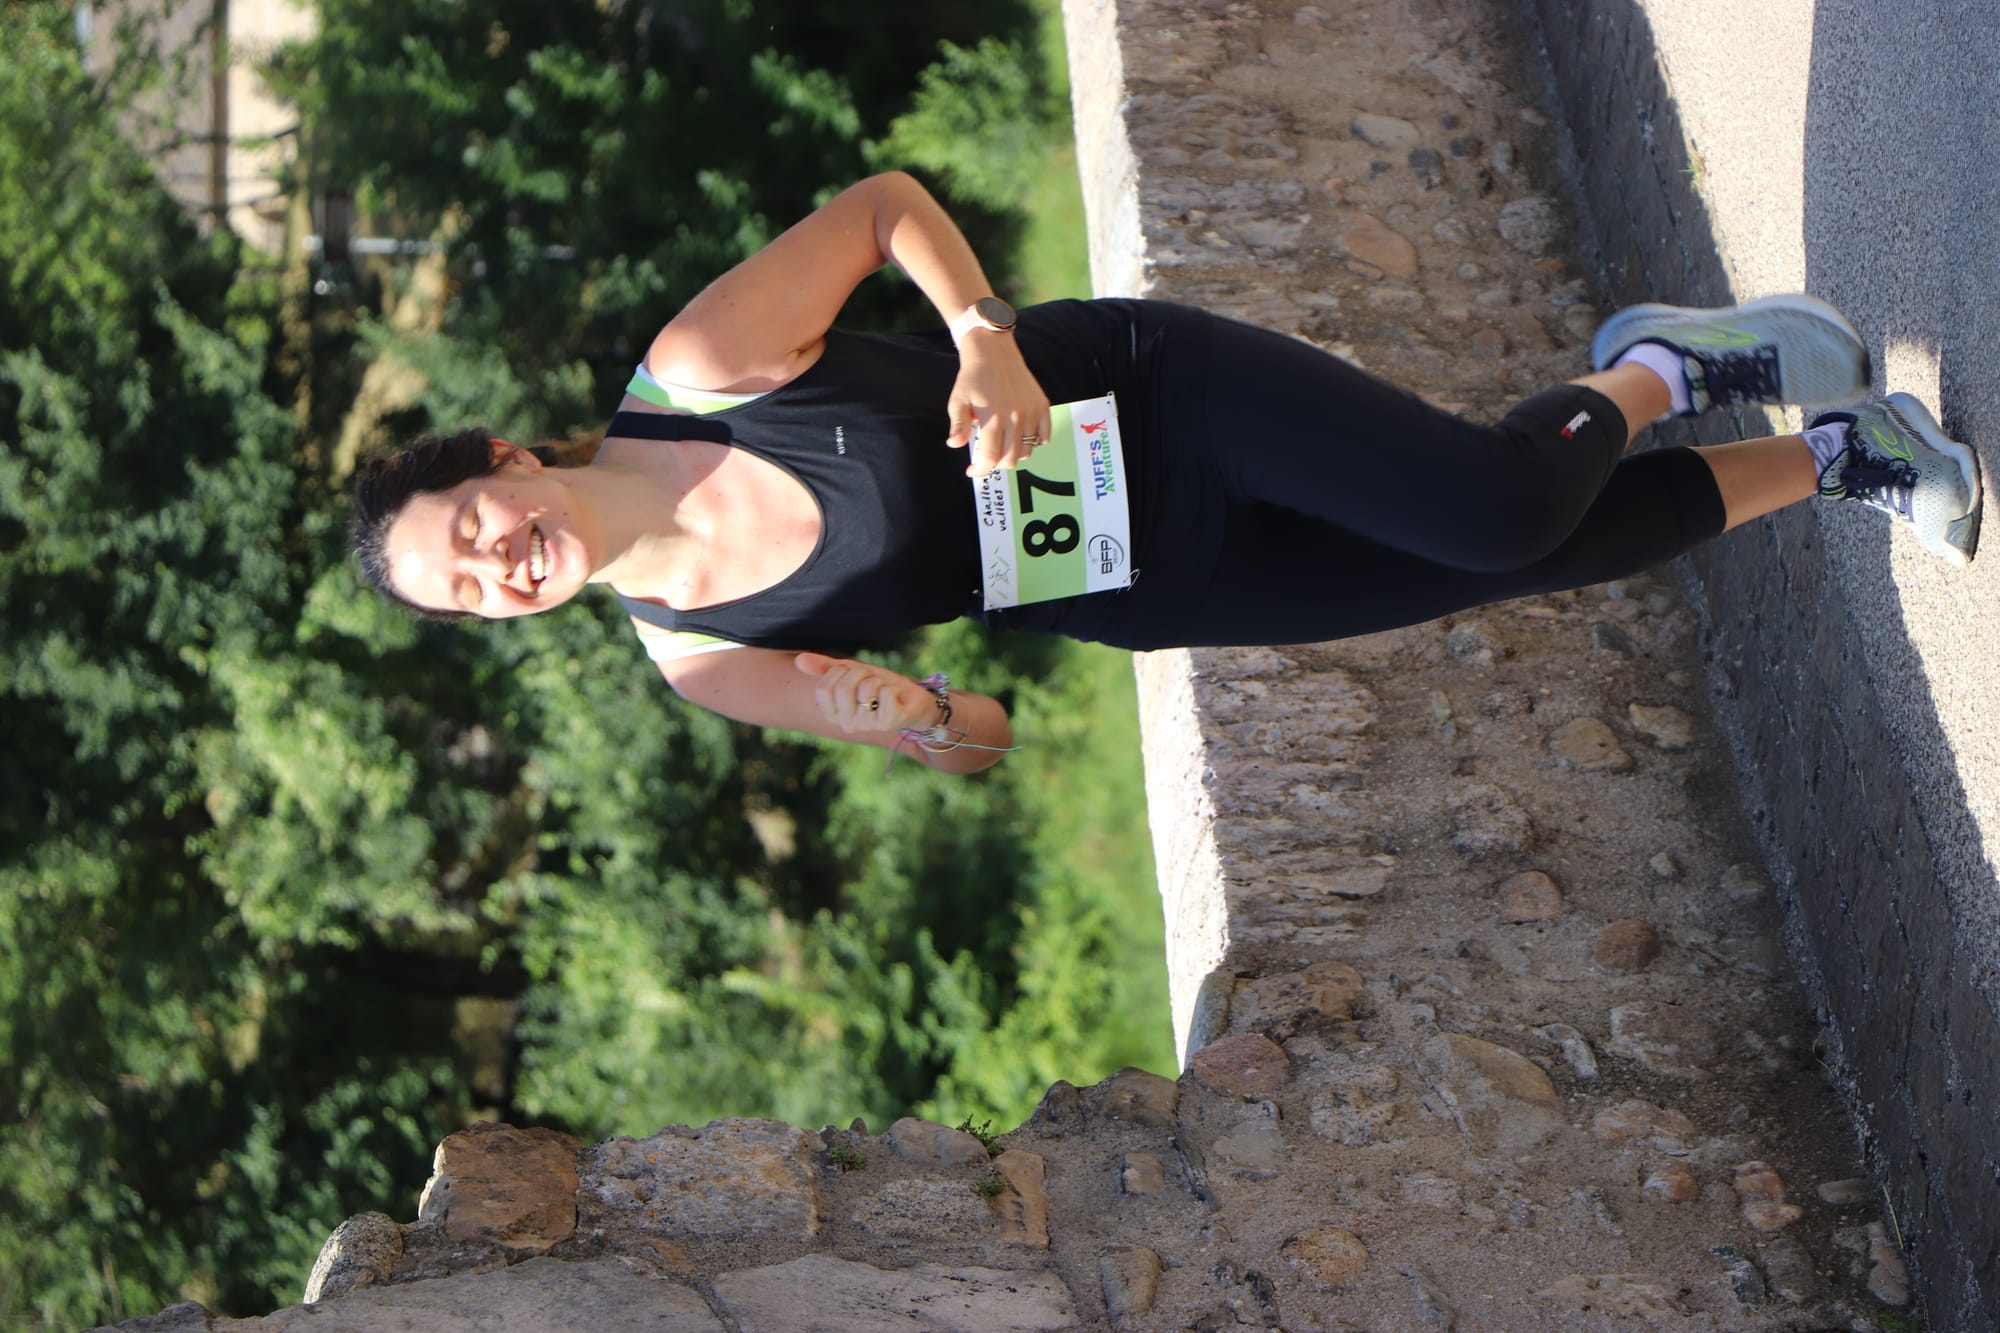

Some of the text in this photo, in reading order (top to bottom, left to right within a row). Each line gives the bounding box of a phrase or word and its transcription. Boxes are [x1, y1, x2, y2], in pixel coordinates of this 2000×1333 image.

[1090, 439, 1108, 500] TUFF'S
[1100, 431, 1115, 492] Aventure
[981, 471, 994, 526] Challen
[993, 489, 1007, 531] vallées
[1016, 468, 1080, 557] 87
[1101, 540, 1113, 575] BFP
